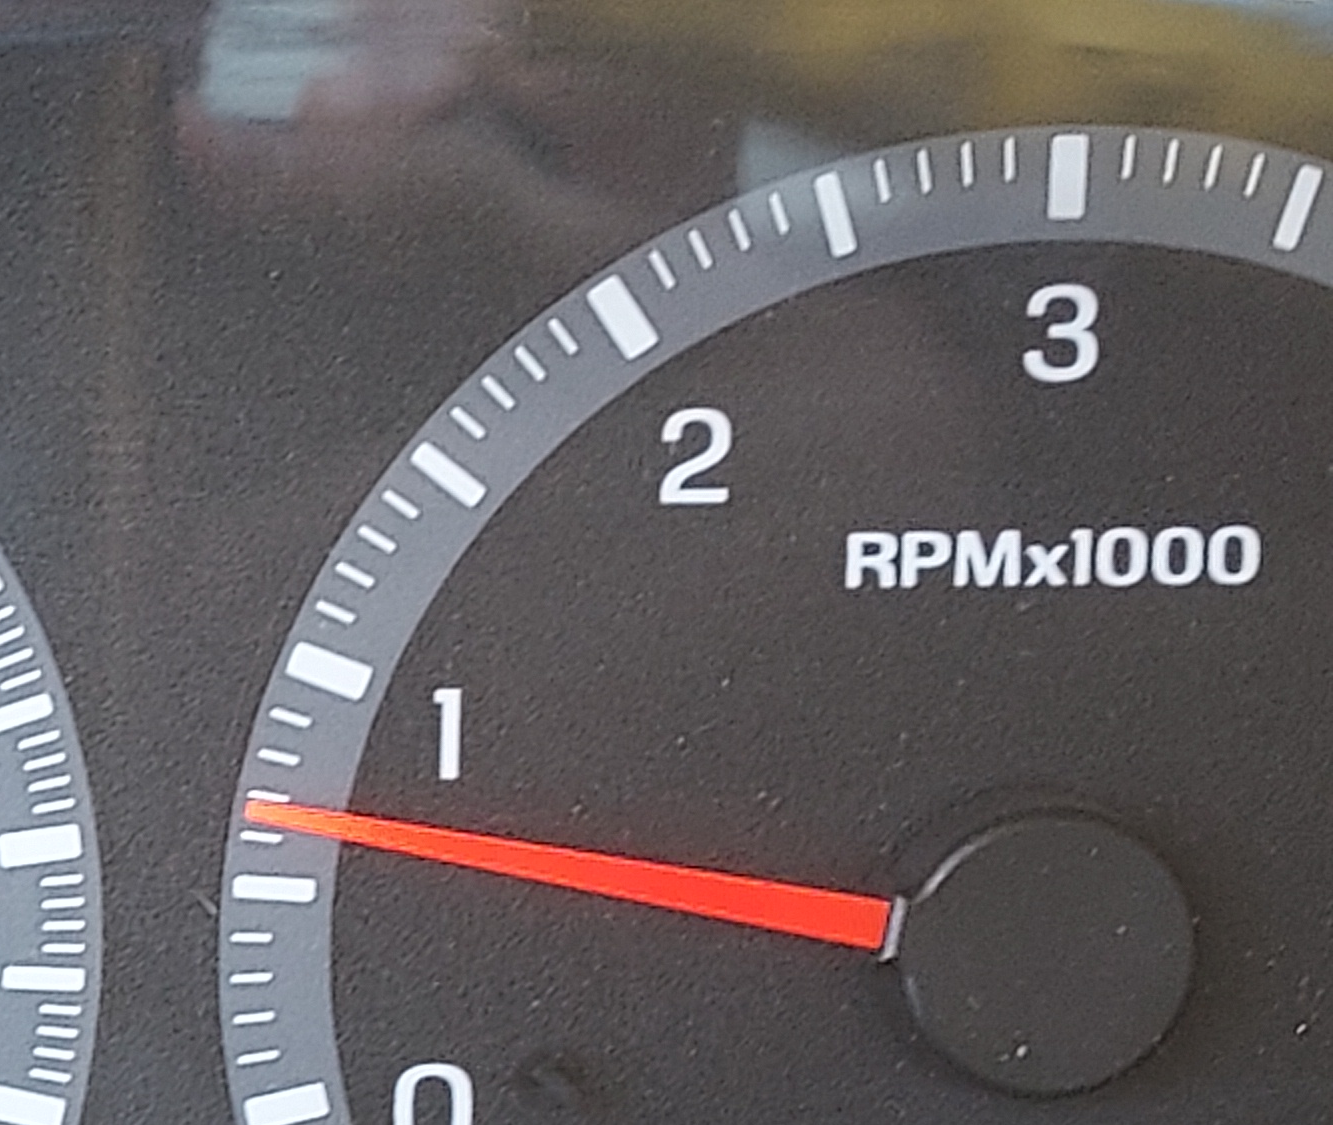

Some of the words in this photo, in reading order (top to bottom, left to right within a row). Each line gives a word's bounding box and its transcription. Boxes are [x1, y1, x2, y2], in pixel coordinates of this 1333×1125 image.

[1023, 283, 1099, 383] 3
[659, 407, 732, 505] 2
[845, 525, 1261, 589] RPMx1000
[433, 688, 462, 781] 1
